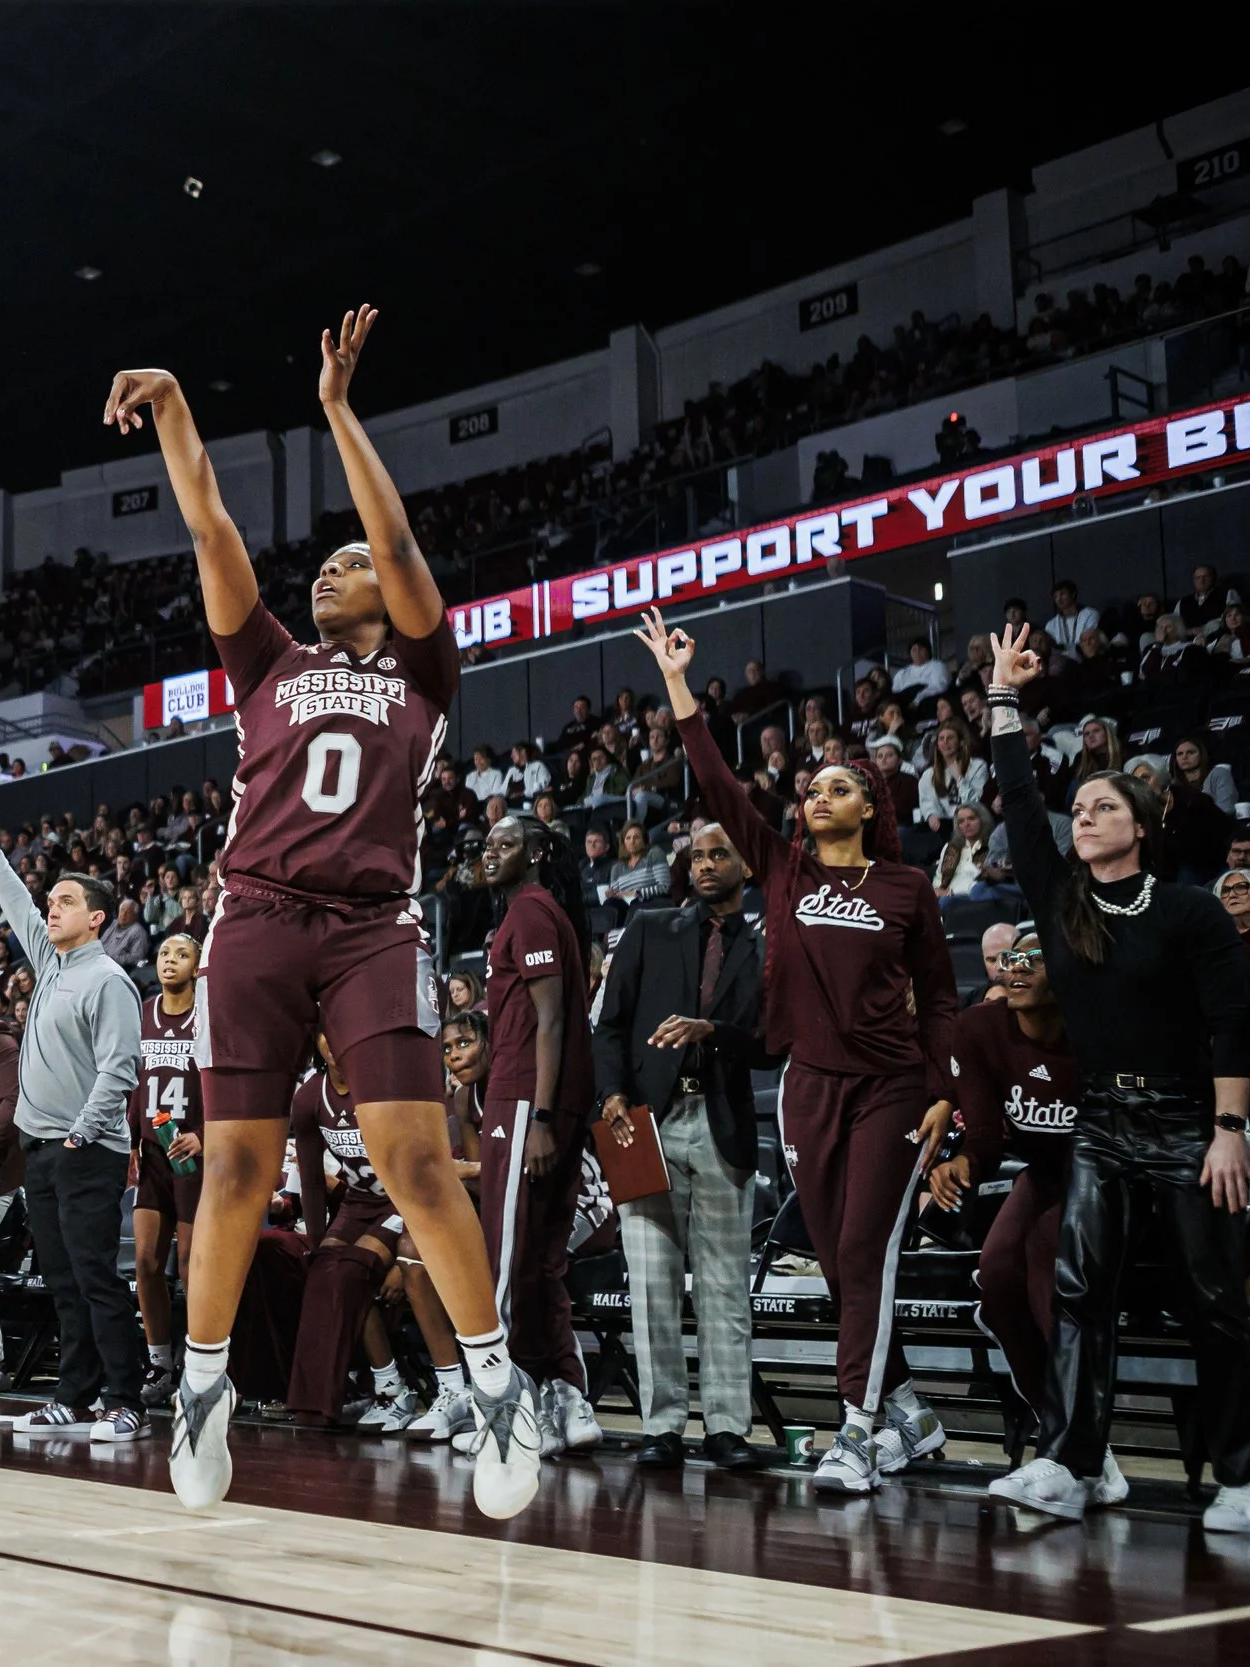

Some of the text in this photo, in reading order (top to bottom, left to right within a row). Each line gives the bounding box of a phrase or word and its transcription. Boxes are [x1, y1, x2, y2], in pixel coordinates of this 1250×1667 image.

[1194, 151, 1240, 185] 210
[810, 293, 847, 323] 209
[121, 491, 149, 511] 207
[572, 499, 888, 620] SUPPORT
[908, 433, 1141, 531] YOUR
[168, 683, 206, 698] BULLDOG
[275, 672, 406, 704] MISSISSIPPI
[168, 693, 205, 713] CLUB
[306, 696, 372, 716] STATE
[301, 732, 362, 815] 0
[795, 884, 884, 931] State
[525, 950, 554, 967] ONE
[151, 1057, 181, 1066] STATE
[145, 1076, 189, 1119] 14
[1004, 1085, 1078, 1133] State
[593, 1294, 623, 1307] HAIL
[753, 1299, 794, 1313] STATE
[910, 1304, 958, 1318] STATE
